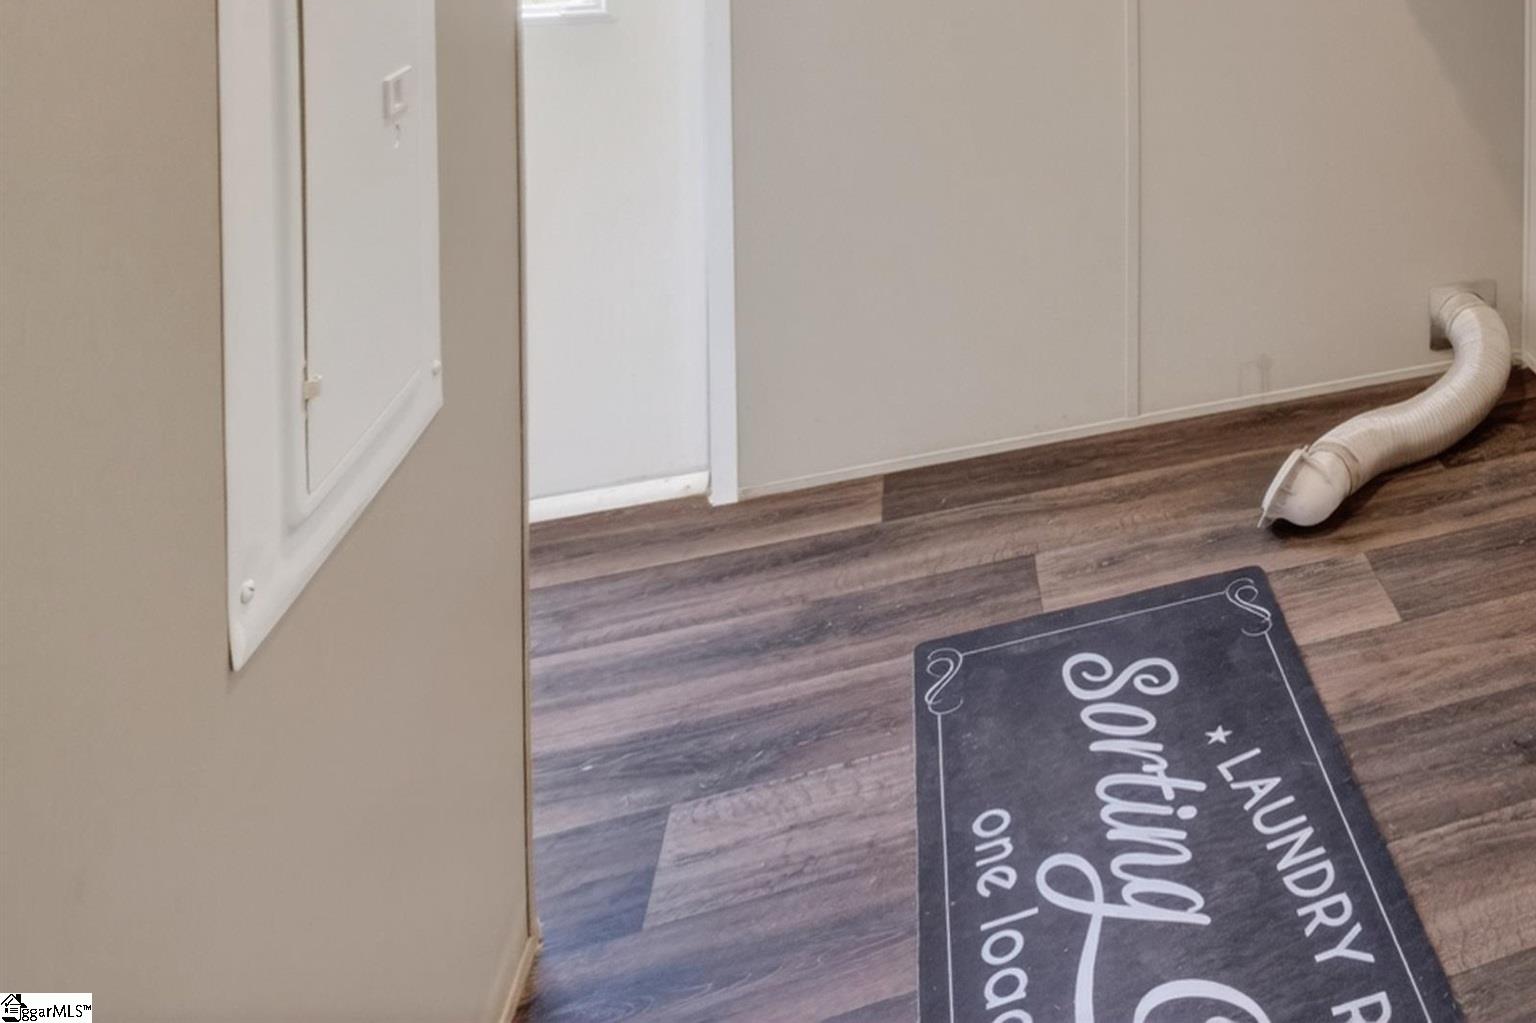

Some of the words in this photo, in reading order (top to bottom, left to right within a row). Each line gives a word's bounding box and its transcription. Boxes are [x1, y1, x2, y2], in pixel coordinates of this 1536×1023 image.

[972, 809, 1018, 898] one
[1036, 652, 1212, 936] Sorting
[1217, 747, 1376, 964] LAUNDRY
